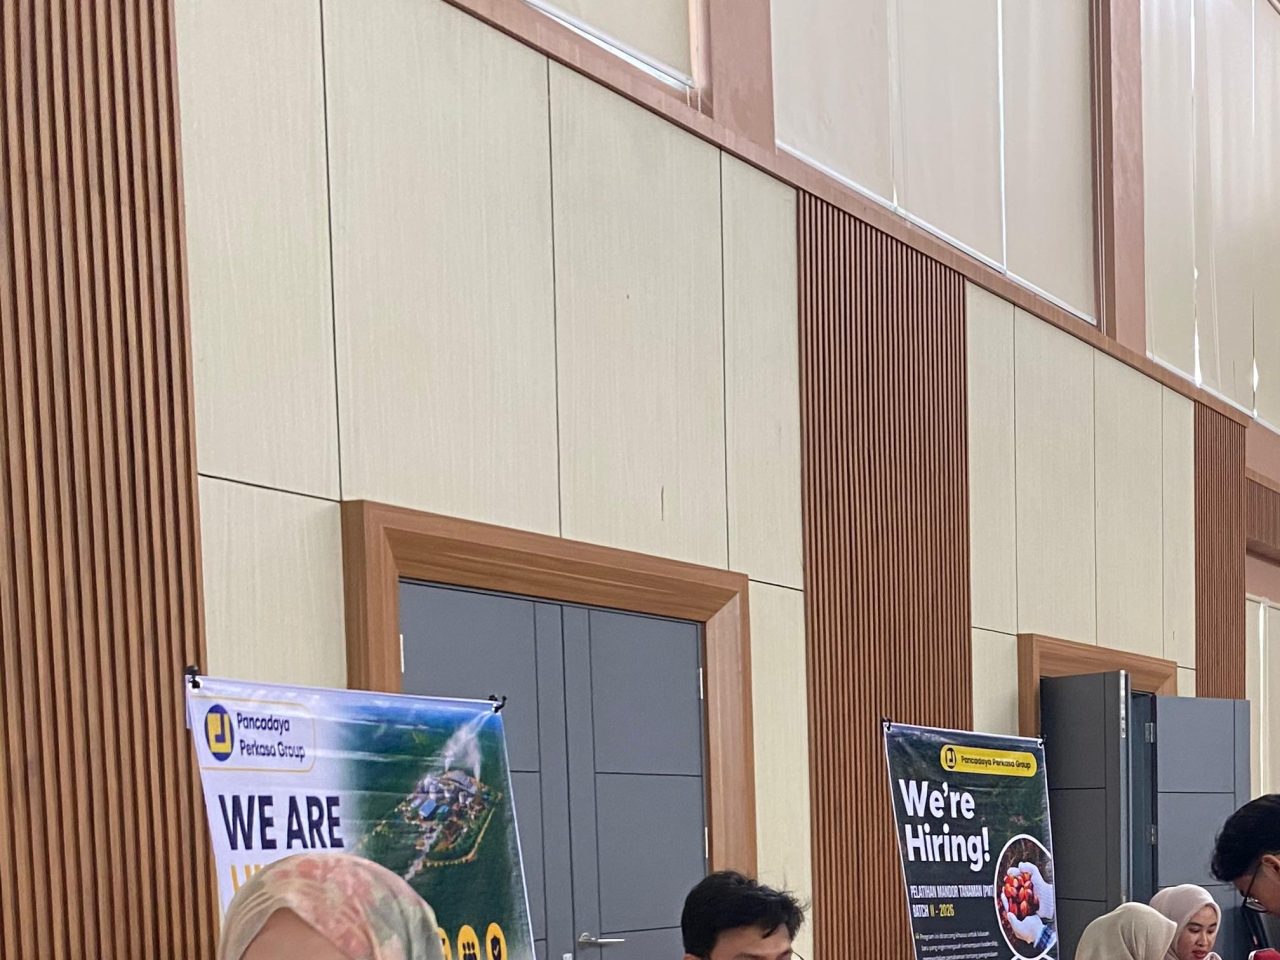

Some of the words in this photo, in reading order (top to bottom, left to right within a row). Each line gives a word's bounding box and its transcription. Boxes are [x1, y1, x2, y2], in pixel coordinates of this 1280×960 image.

[237, 712, 290, 736] Pancadaya
[239, 740, 278, 759] Perkasa
[277, 741, 306, 762] Group
[961, 755, 992, 767] Pancadaya
[992, 758, 1015, 768] Perkasa
[1015, 760, 1031, 770] Group
[898, 779, 975, 819] We're
[218, 795, 277, 850] WE
[286, 796, 344, 849] ARE
[904, 823, 990, 872] Hiring!
